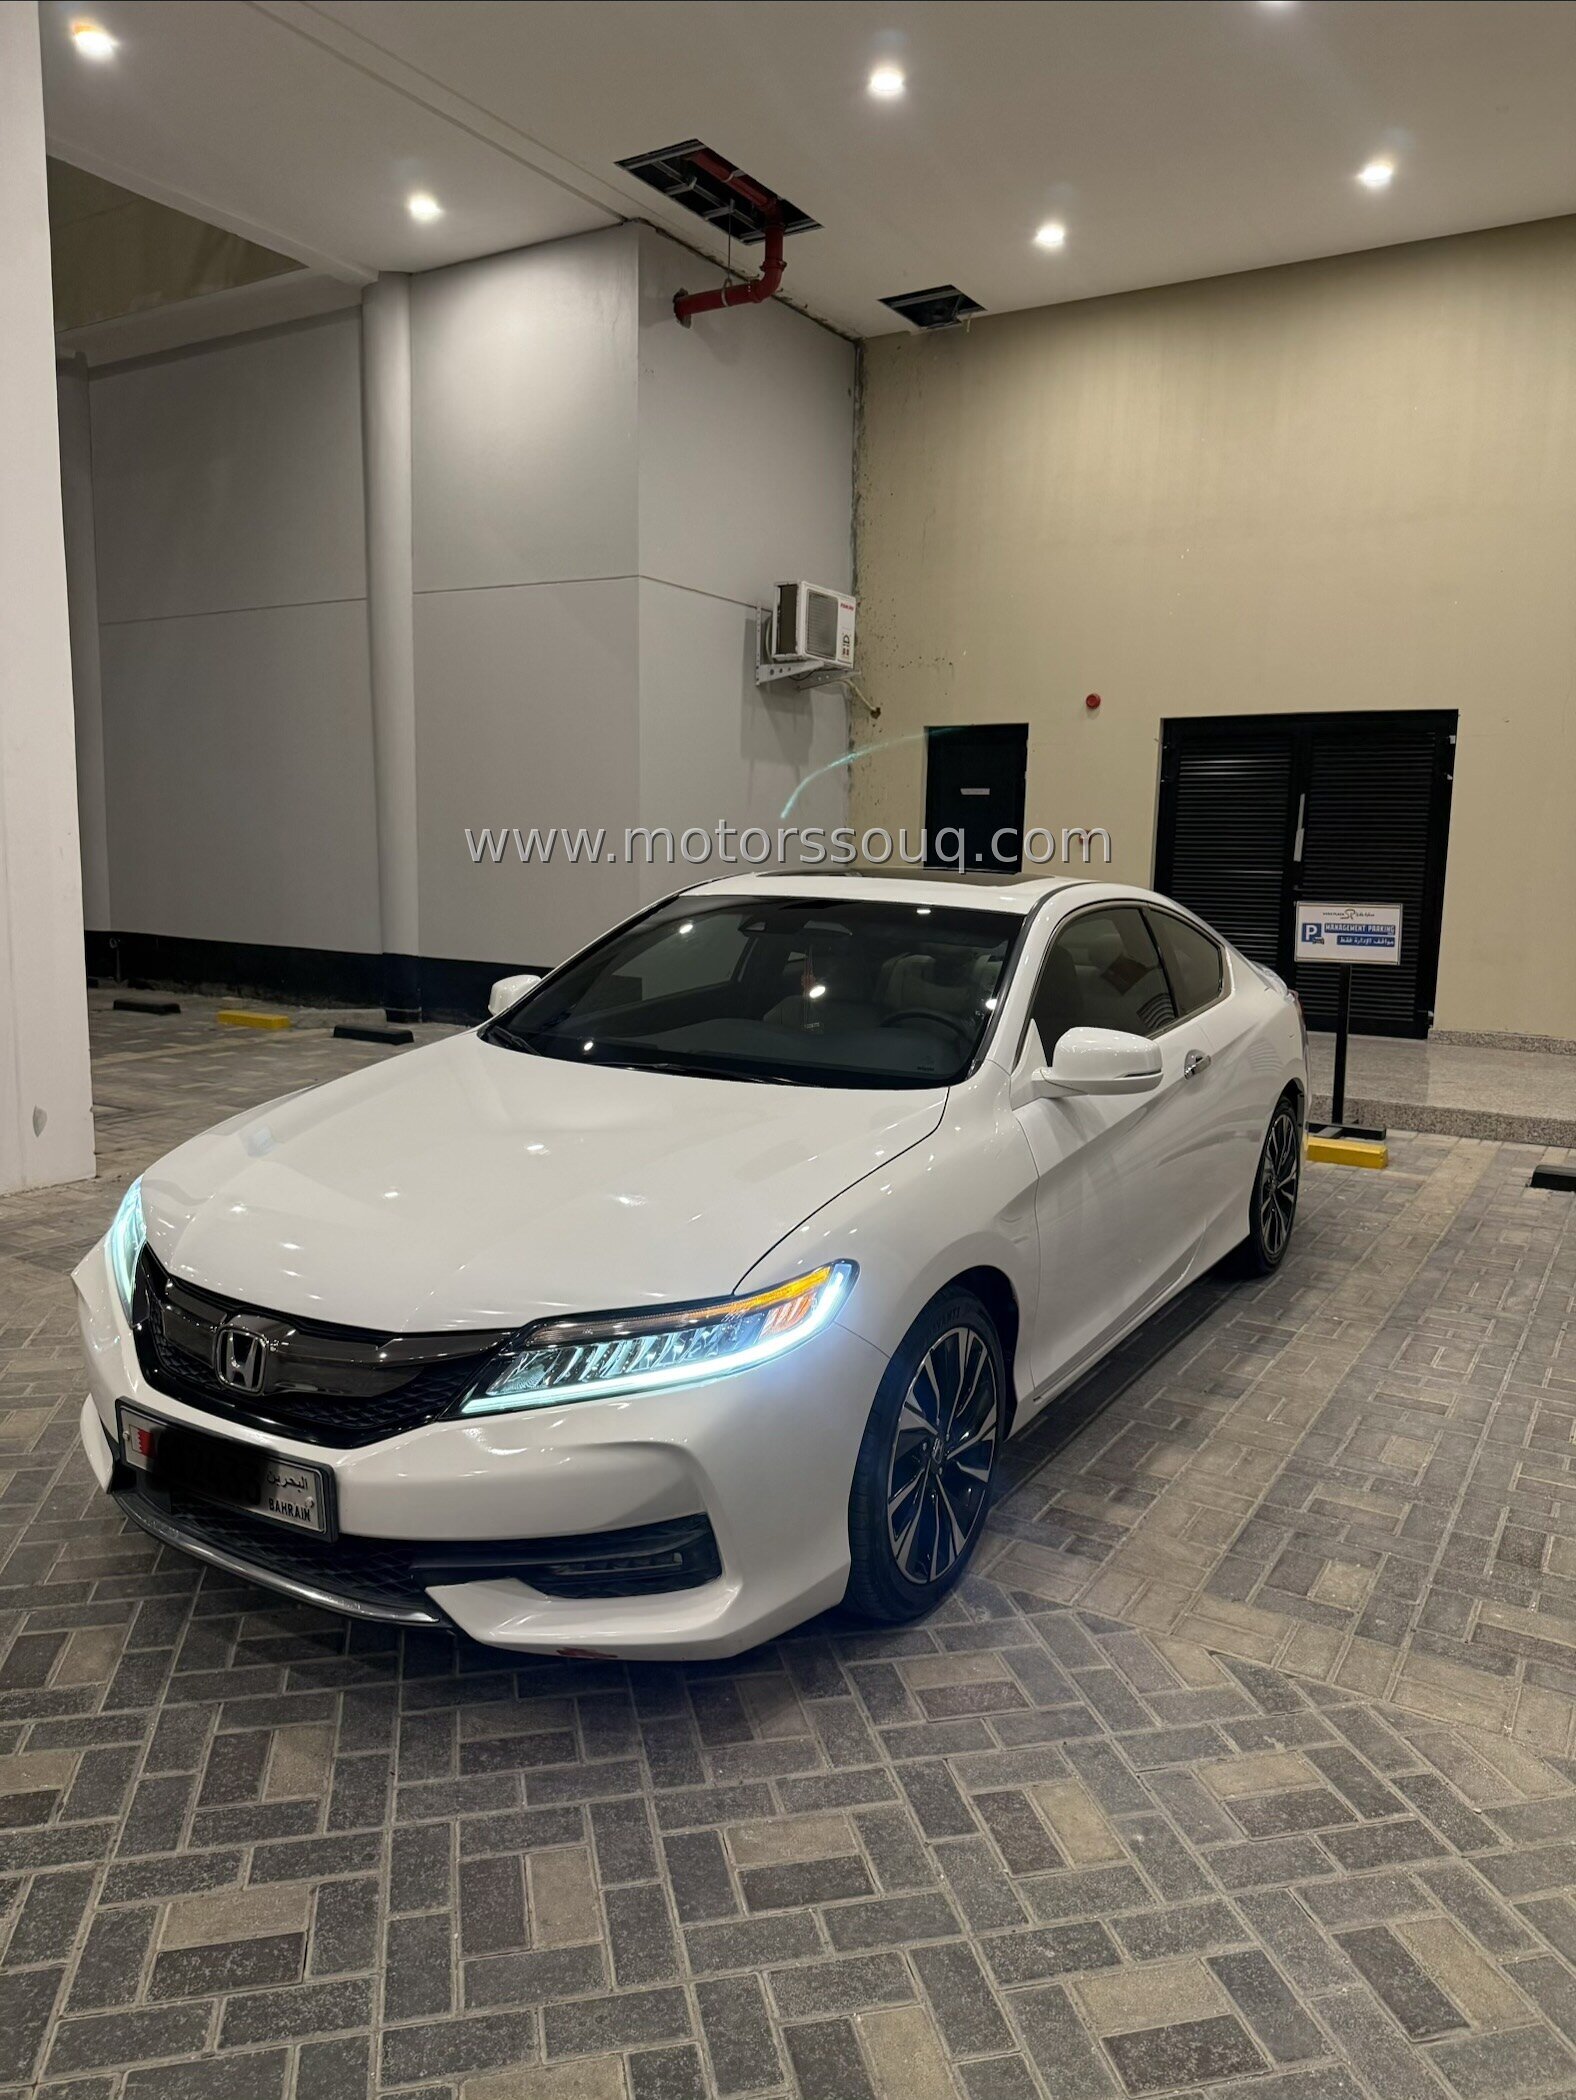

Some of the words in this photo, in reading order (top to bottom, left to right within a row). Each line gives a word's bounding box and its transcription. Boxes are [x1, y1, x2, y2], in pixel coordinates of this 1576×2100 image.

[1306, 925, 1317, 941] P
[1325, 924, 1366, 932] MANAGEMENT
[1367, 925, 1395, 933] PARKING
[266, 1471, 308, 1493] البحرين
[268, 1497, 311, 1522] BAHRAIN
